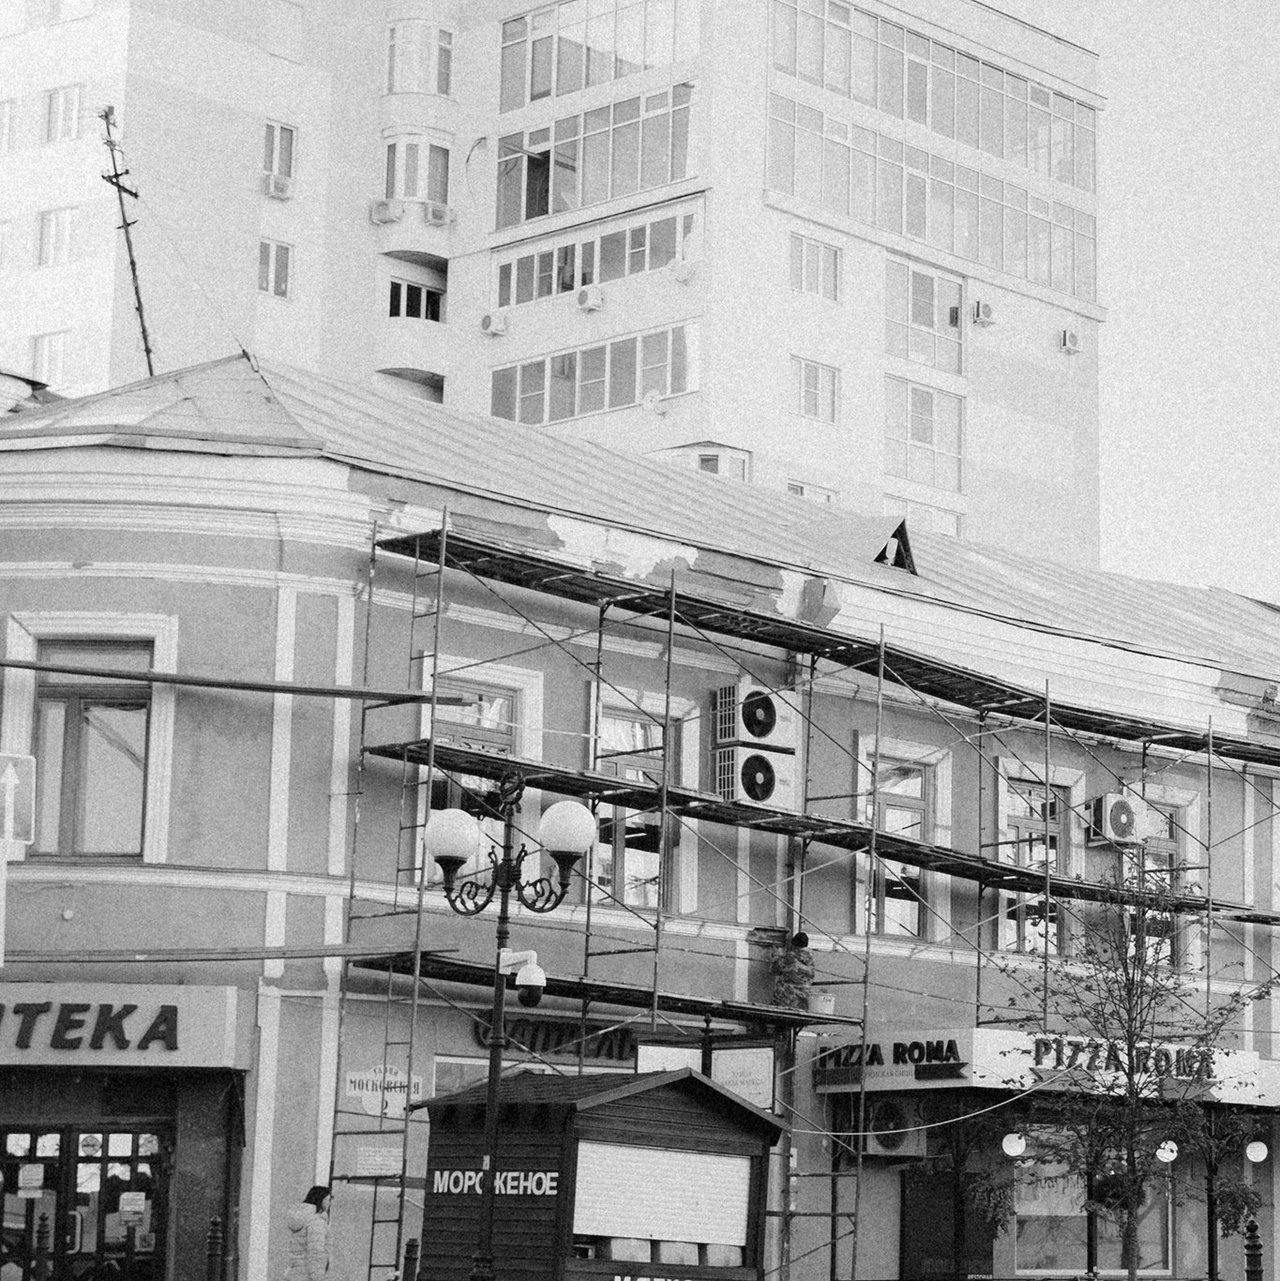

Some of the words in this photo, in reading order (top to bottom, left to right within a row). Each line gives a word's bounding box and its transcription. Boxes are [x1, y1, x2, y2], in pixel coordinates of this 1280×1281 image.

[0, 1002, 179, 1051] ТЕКА
[819, 1043, 884, 1068] PIZZA
[893, 1039, 960, 1065] ROMA
[1034, 1038, 1123, 1071] PIZZA
[349, 1078, 420, 1095] МОСКОВСКЯ
